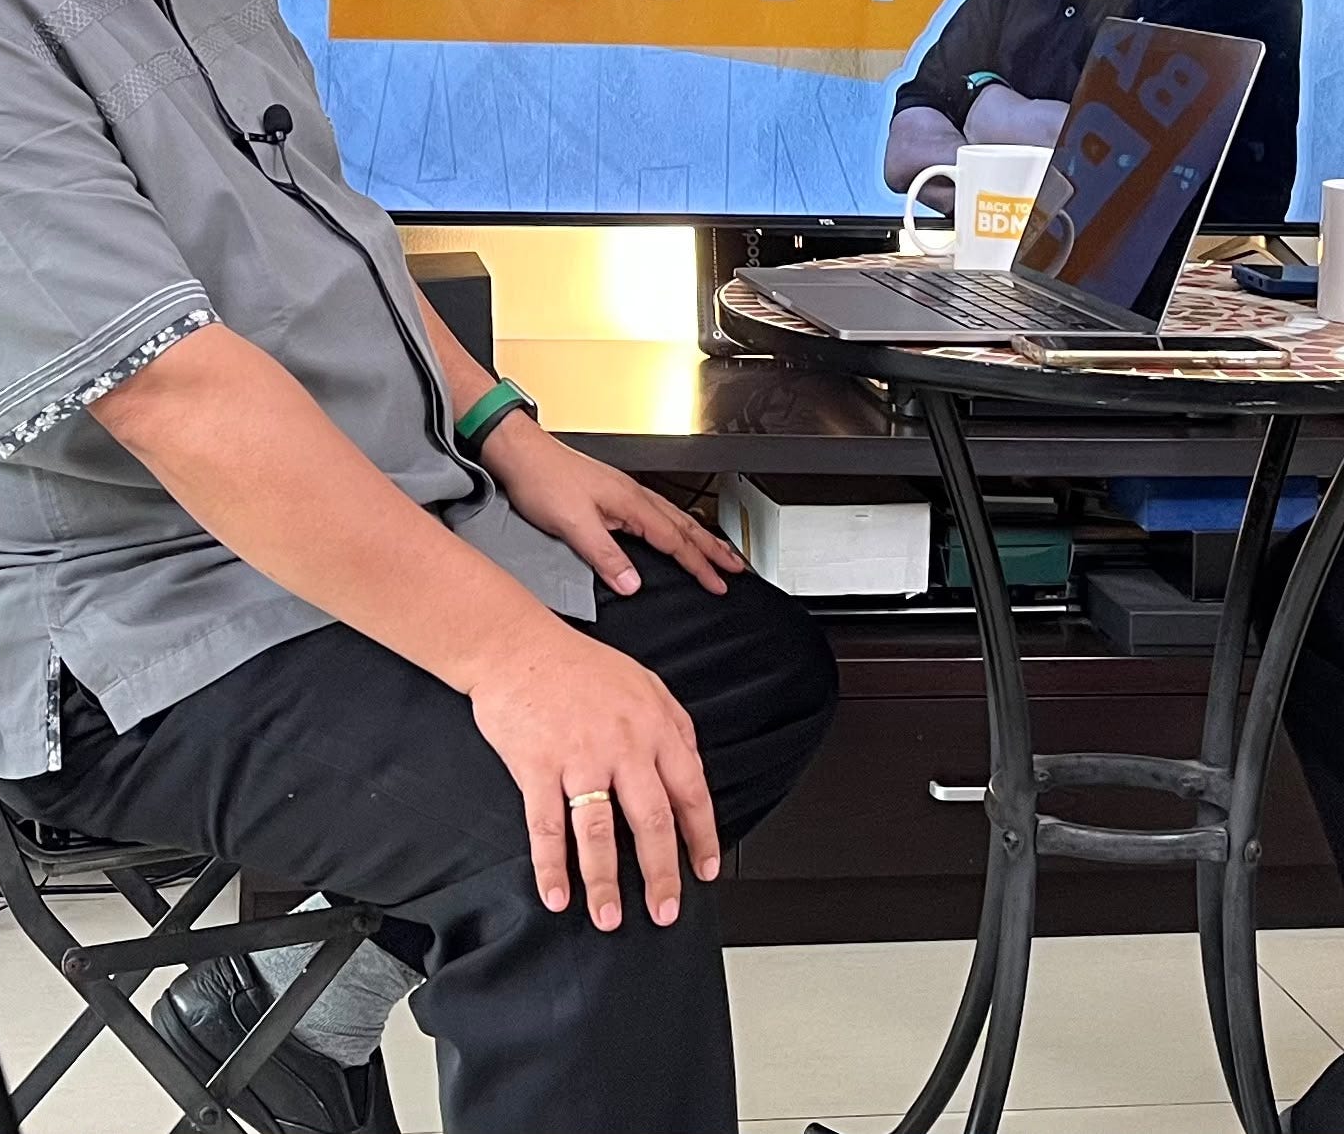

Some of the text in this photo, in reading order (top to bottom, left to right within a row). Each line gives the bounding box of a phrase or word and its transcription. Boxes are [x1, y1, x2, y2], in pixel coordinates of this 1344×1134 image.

[978, 200, 1031, 215] BACK TO
[818, 218, 835, 226] TCL
